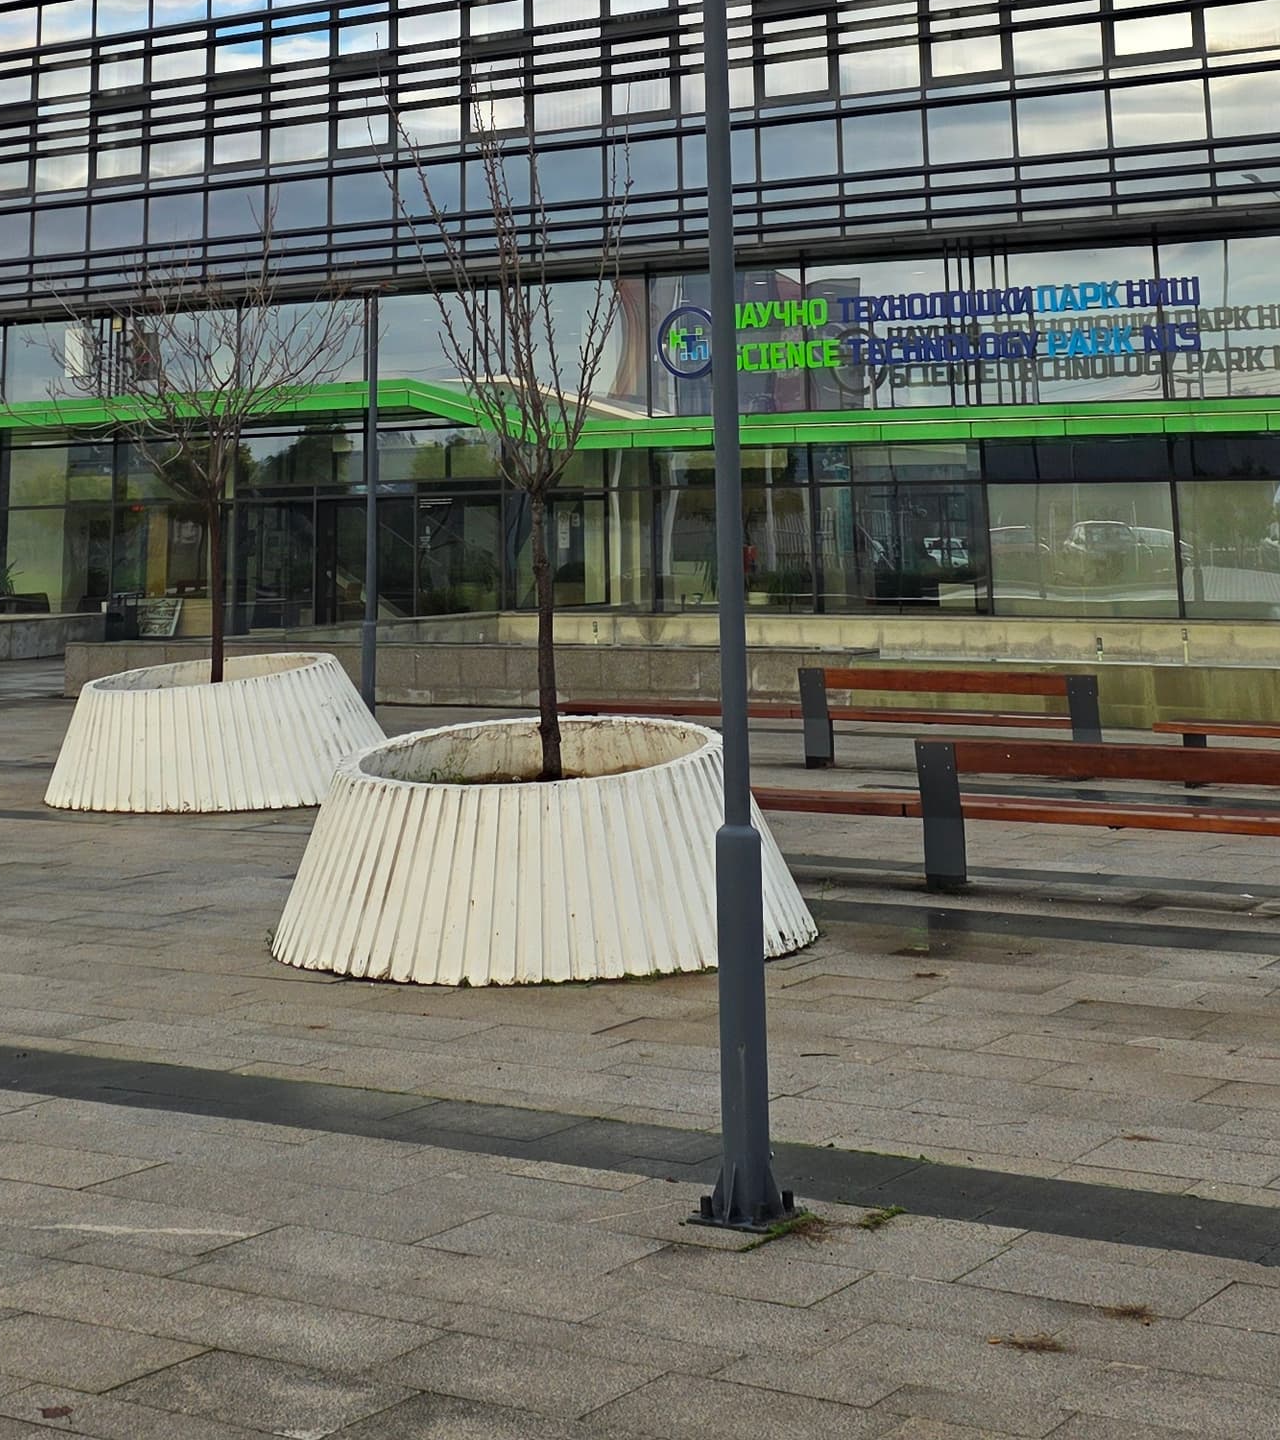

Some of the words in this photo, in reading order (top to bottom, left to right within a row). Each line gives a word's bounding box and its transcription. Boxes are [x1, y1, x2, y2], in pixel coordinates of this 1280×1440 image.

[1036, 280, 1120, 314] ПАРК
[1125, 276, 1200, 308] НИШ
[847, 330, 1040, 367] TECHNOLOGY
[1047, 325, 1135, 358] PARK
[1142, 321, 1201, 354] NIS
